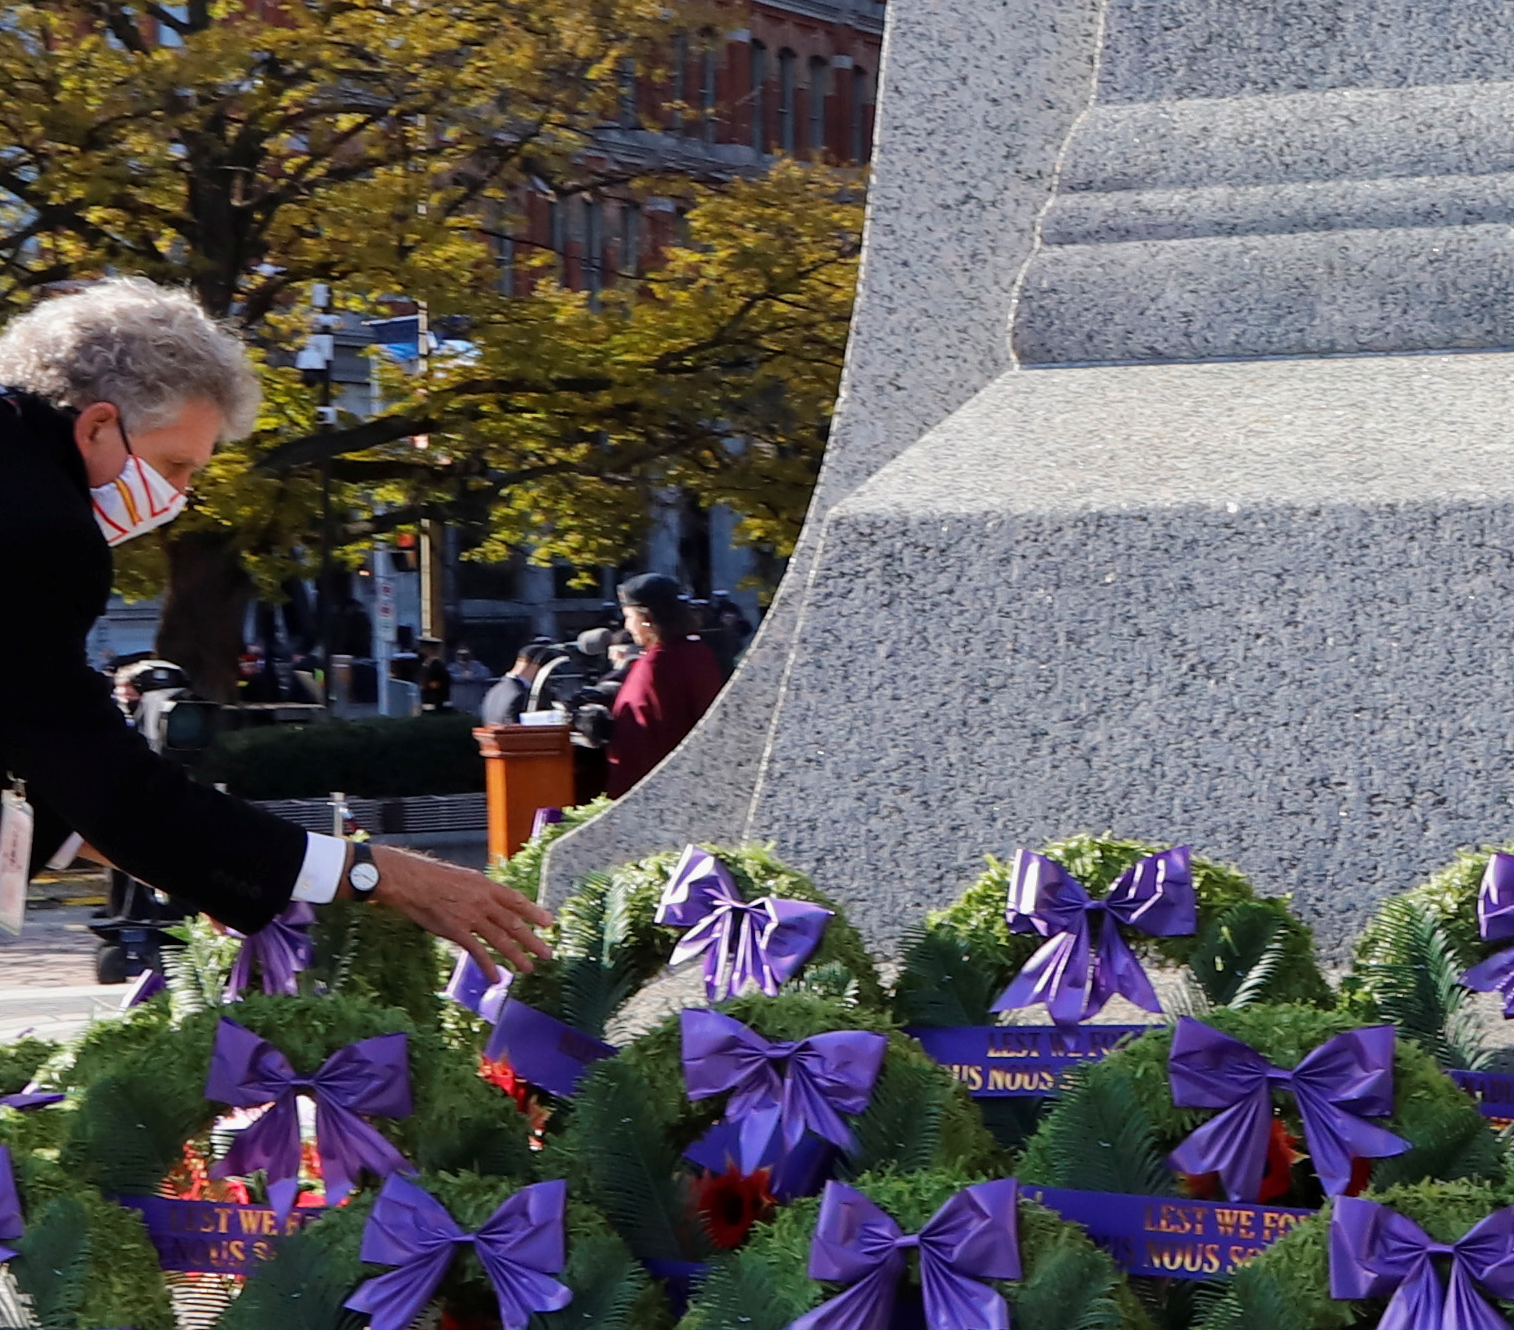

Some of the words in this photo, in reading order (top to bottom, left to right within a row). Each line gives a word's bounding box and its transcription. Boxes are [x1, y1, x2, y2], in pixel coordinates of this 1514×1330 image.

[238, 1208, 279, 1236] WE
[1144, 1203, 1208, 1235] LEST
[1215, 1208, 1255, 1239] WE
[1143, 1240, 1220, 1273] NOUS
